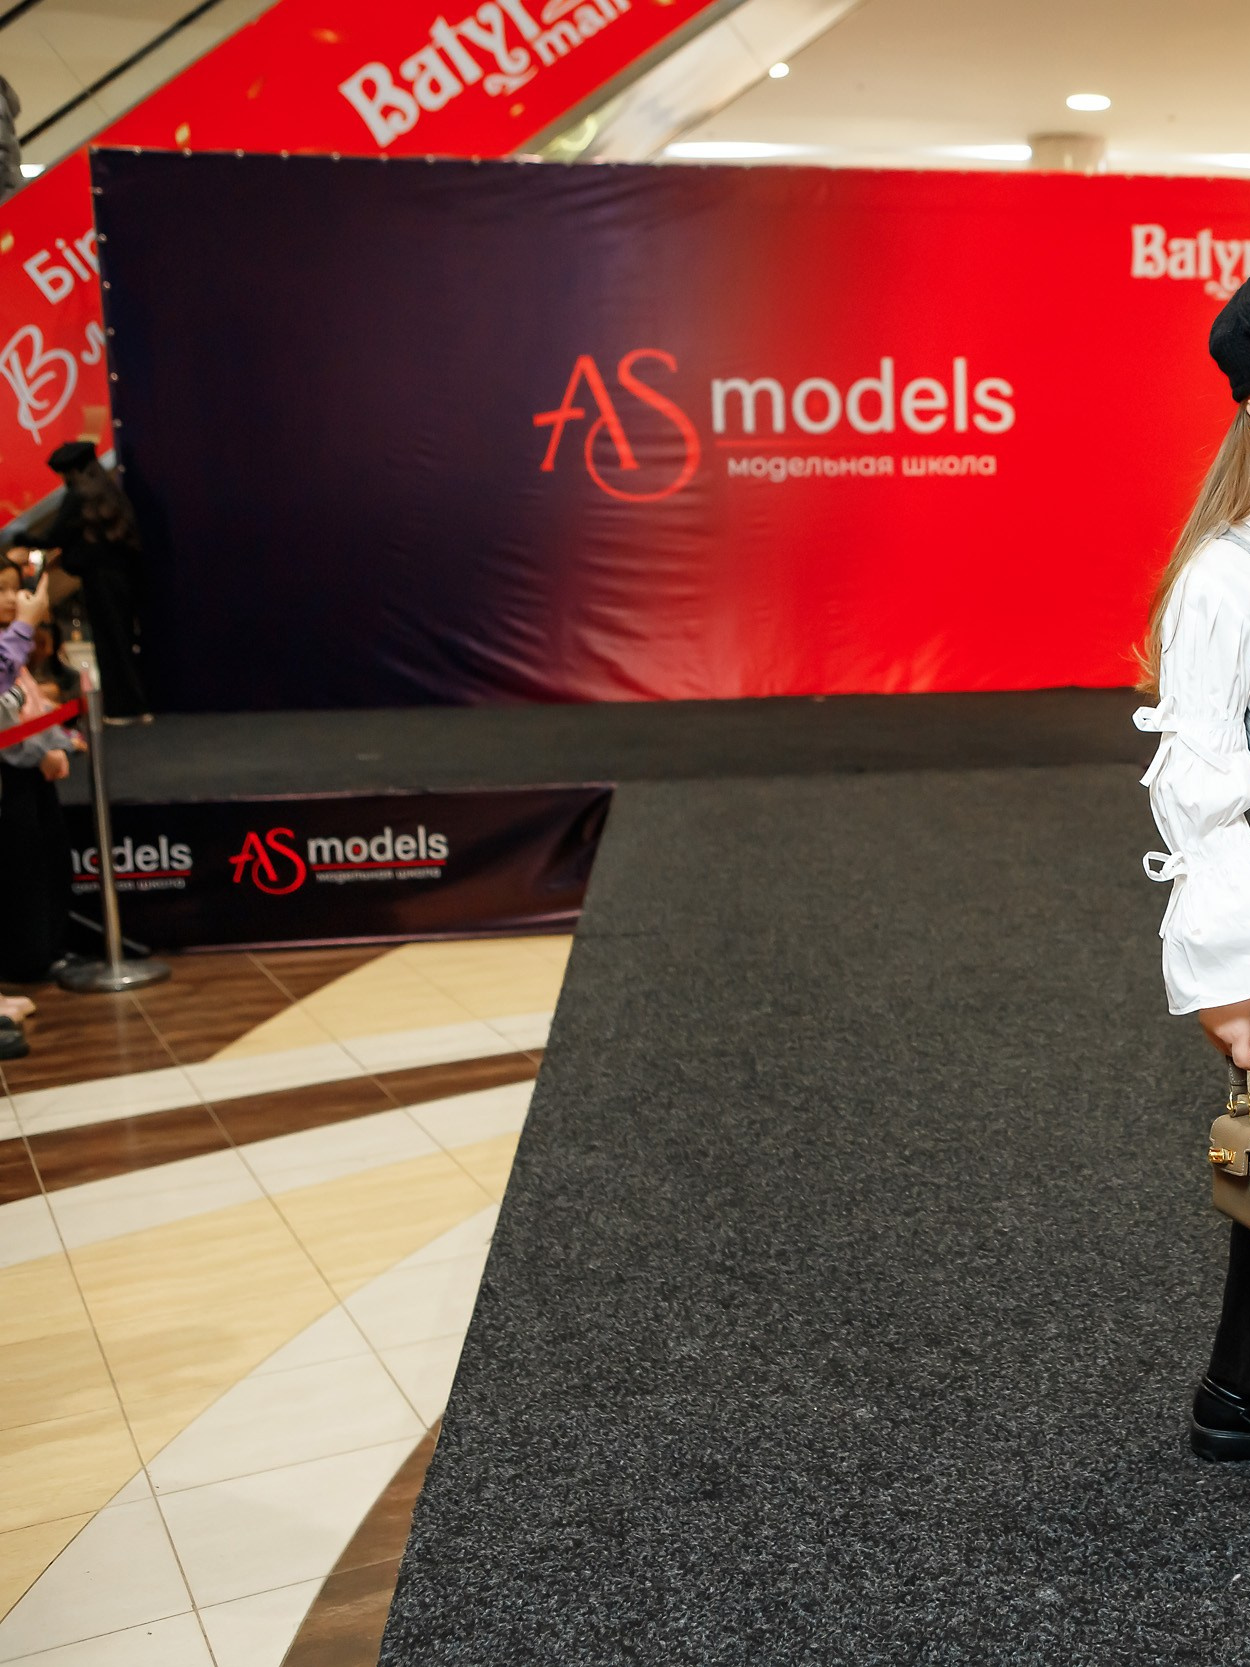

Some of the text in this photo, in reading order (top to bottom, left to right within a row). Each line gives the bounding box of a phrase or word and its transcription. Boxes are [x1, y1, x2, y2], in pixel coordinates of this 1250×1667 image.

[533, 348, 1016, 502] AS models
[727, 455, 997, 483] модельная школа
[228, 825, 449, 895] AS models
